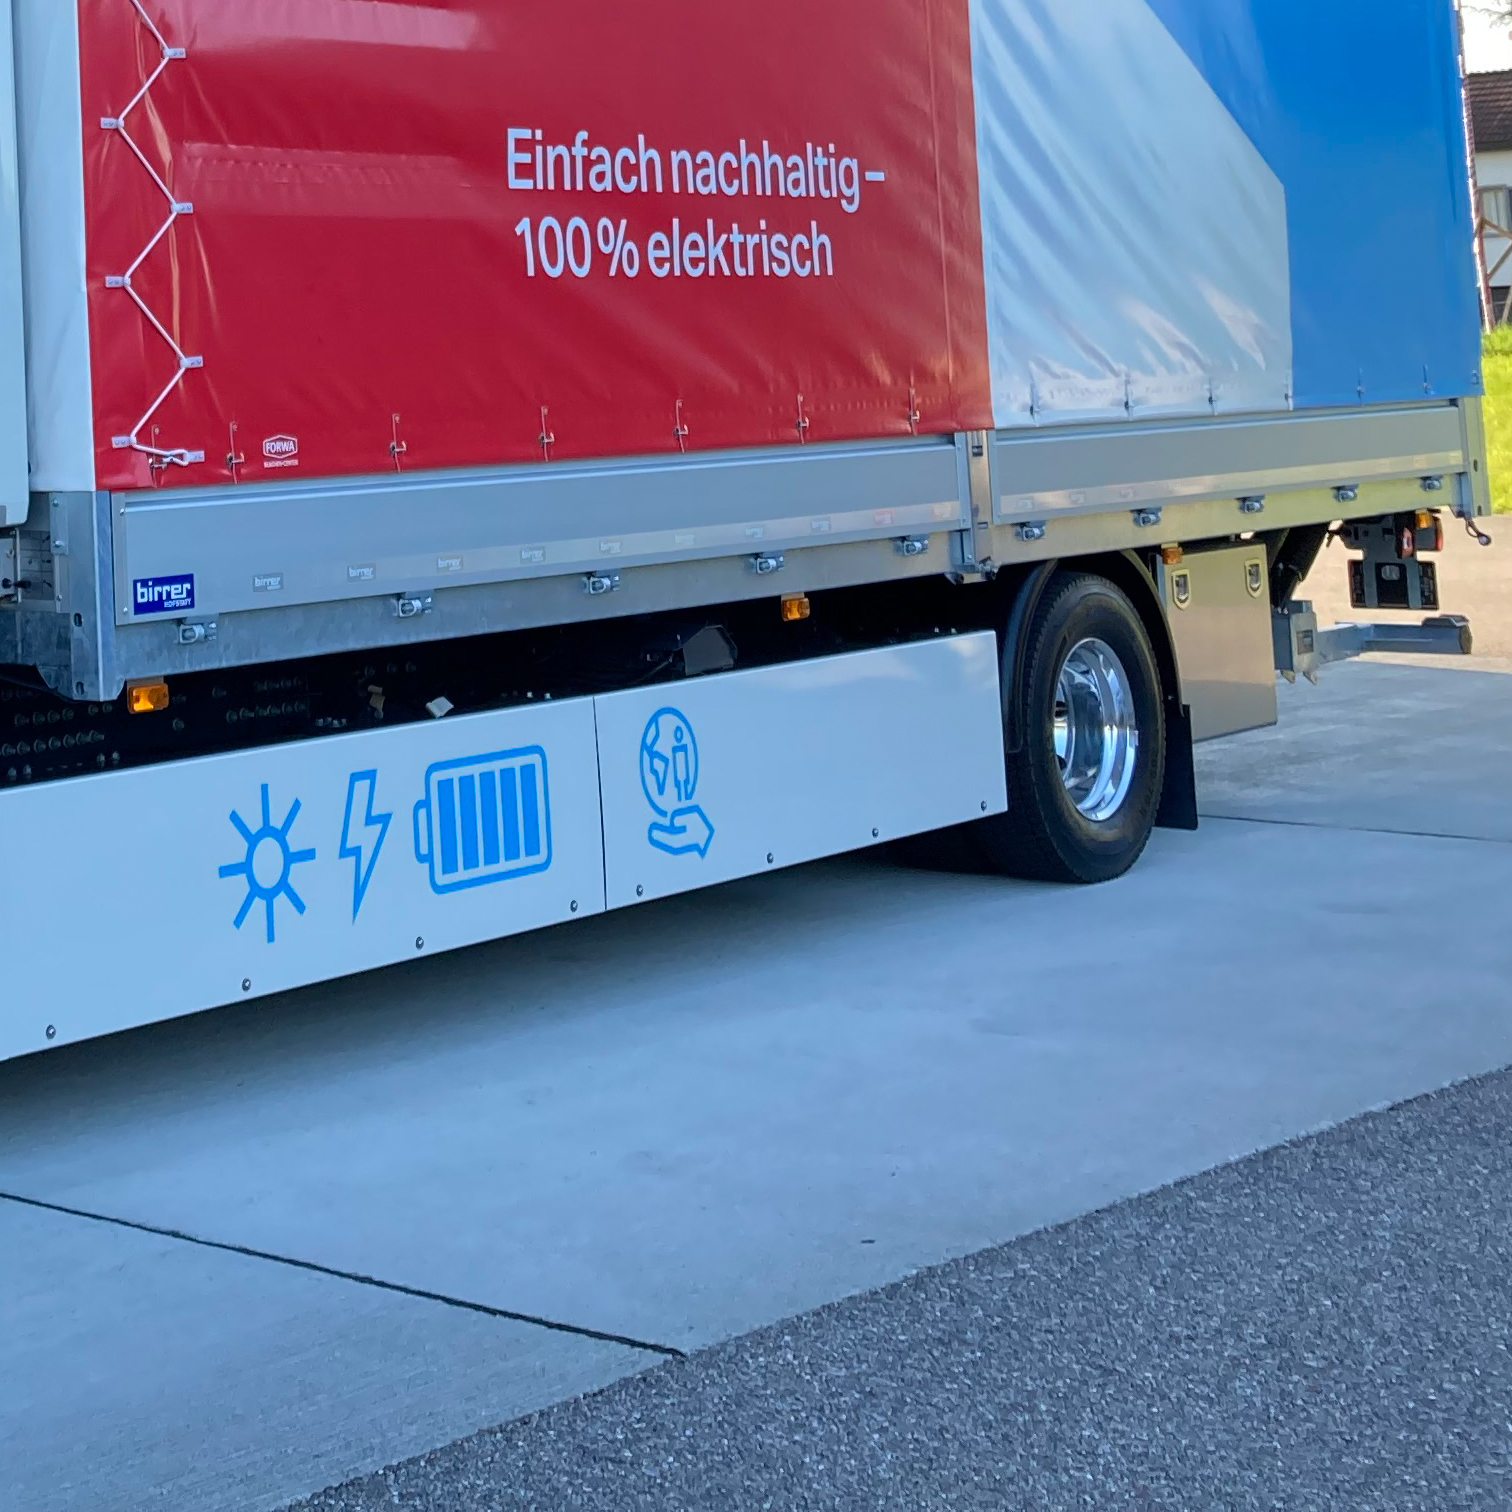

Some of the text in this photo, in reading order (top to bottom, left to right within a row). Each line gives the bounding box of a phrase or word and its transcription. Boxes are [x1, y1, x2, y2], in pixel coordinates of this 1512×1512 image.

[506, 126, 664, 193] Einfach
[646, 217, 834, 277] elektrisch
[265, 440, 296, 454] FORWA
[136, 580, 191, 603] birrer
[254, 576, 281, 587] birrer
